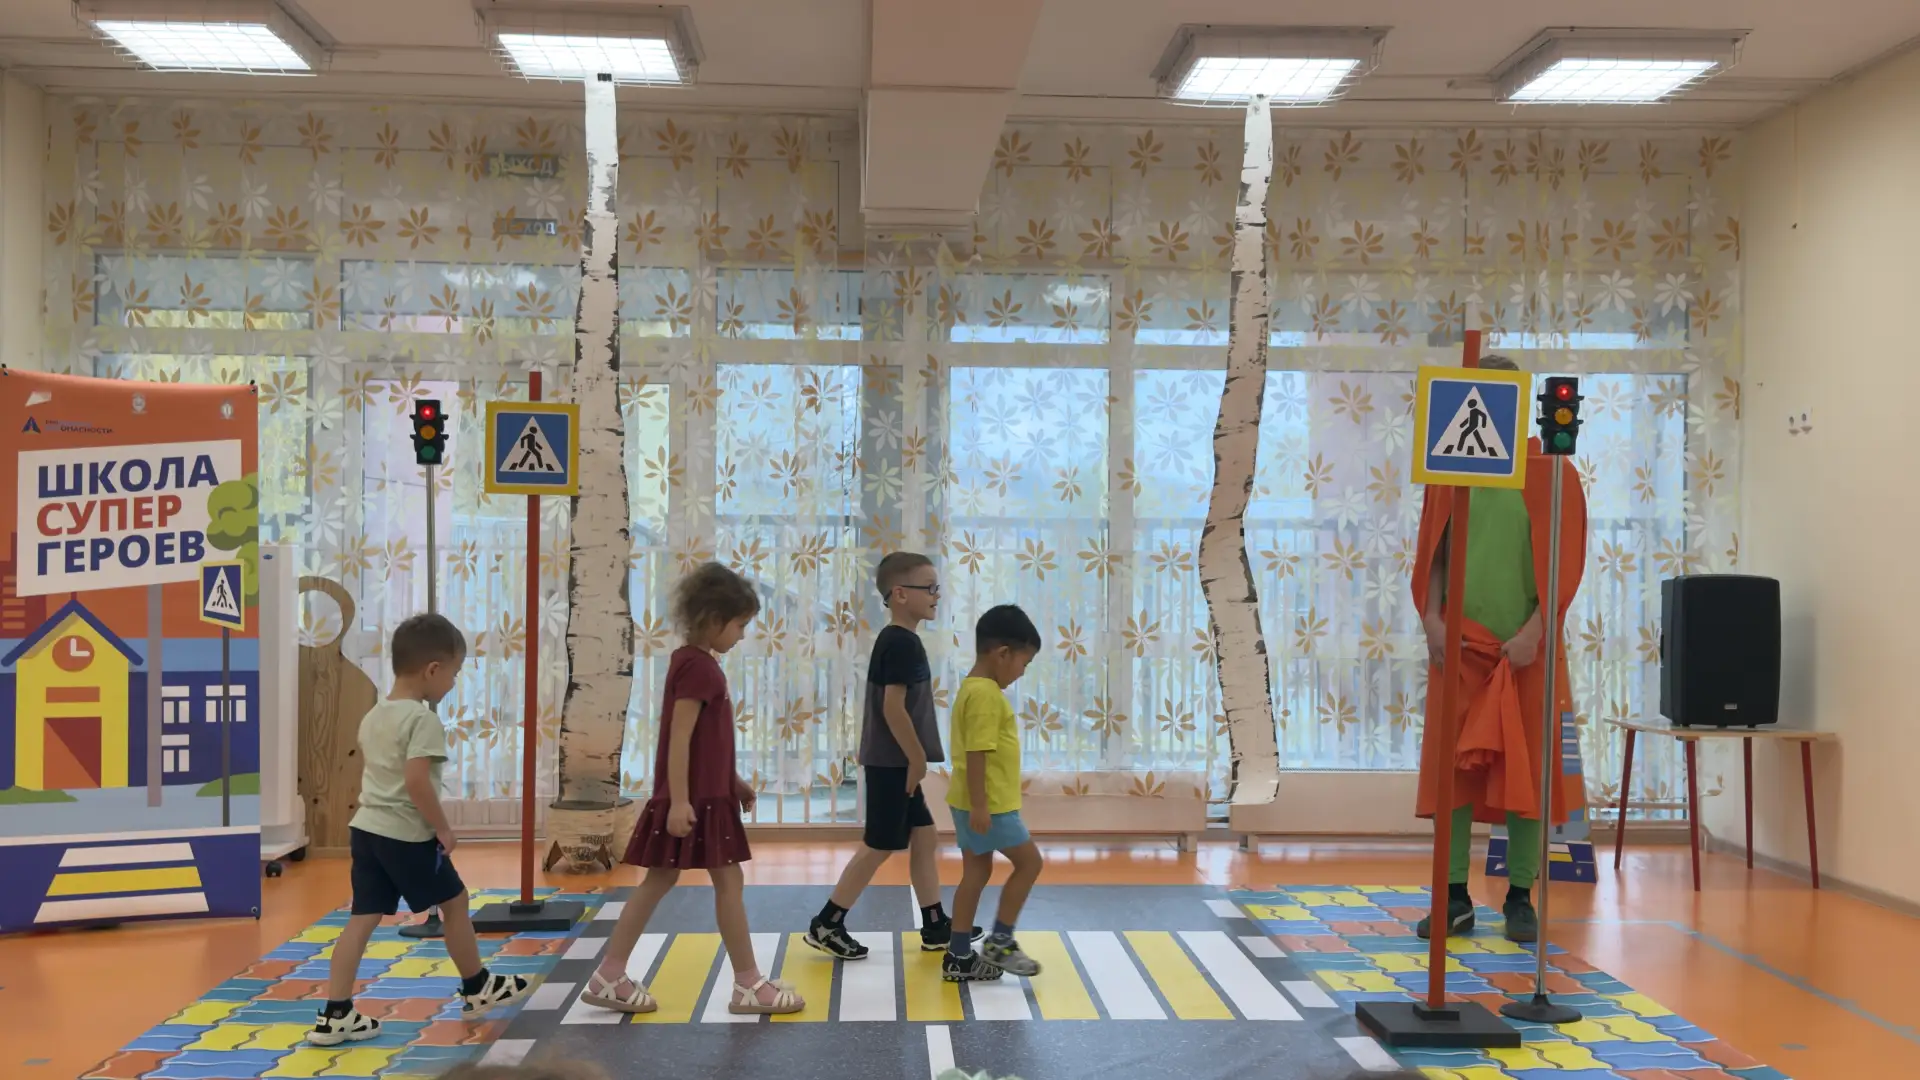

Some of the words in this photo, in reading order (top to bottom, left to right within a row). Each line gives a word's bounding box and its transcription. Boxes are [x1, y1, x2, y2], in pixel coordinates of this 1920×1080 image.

[490, 157, 554, 175] ЫХОД
[500, 221, 556, 235] ХОД
[38, 455, 219, 499] ШКОЛА
[37, 495, 182, 537] СУПЕР
[37, 530, 205, 576] ГЕРОЕВ
